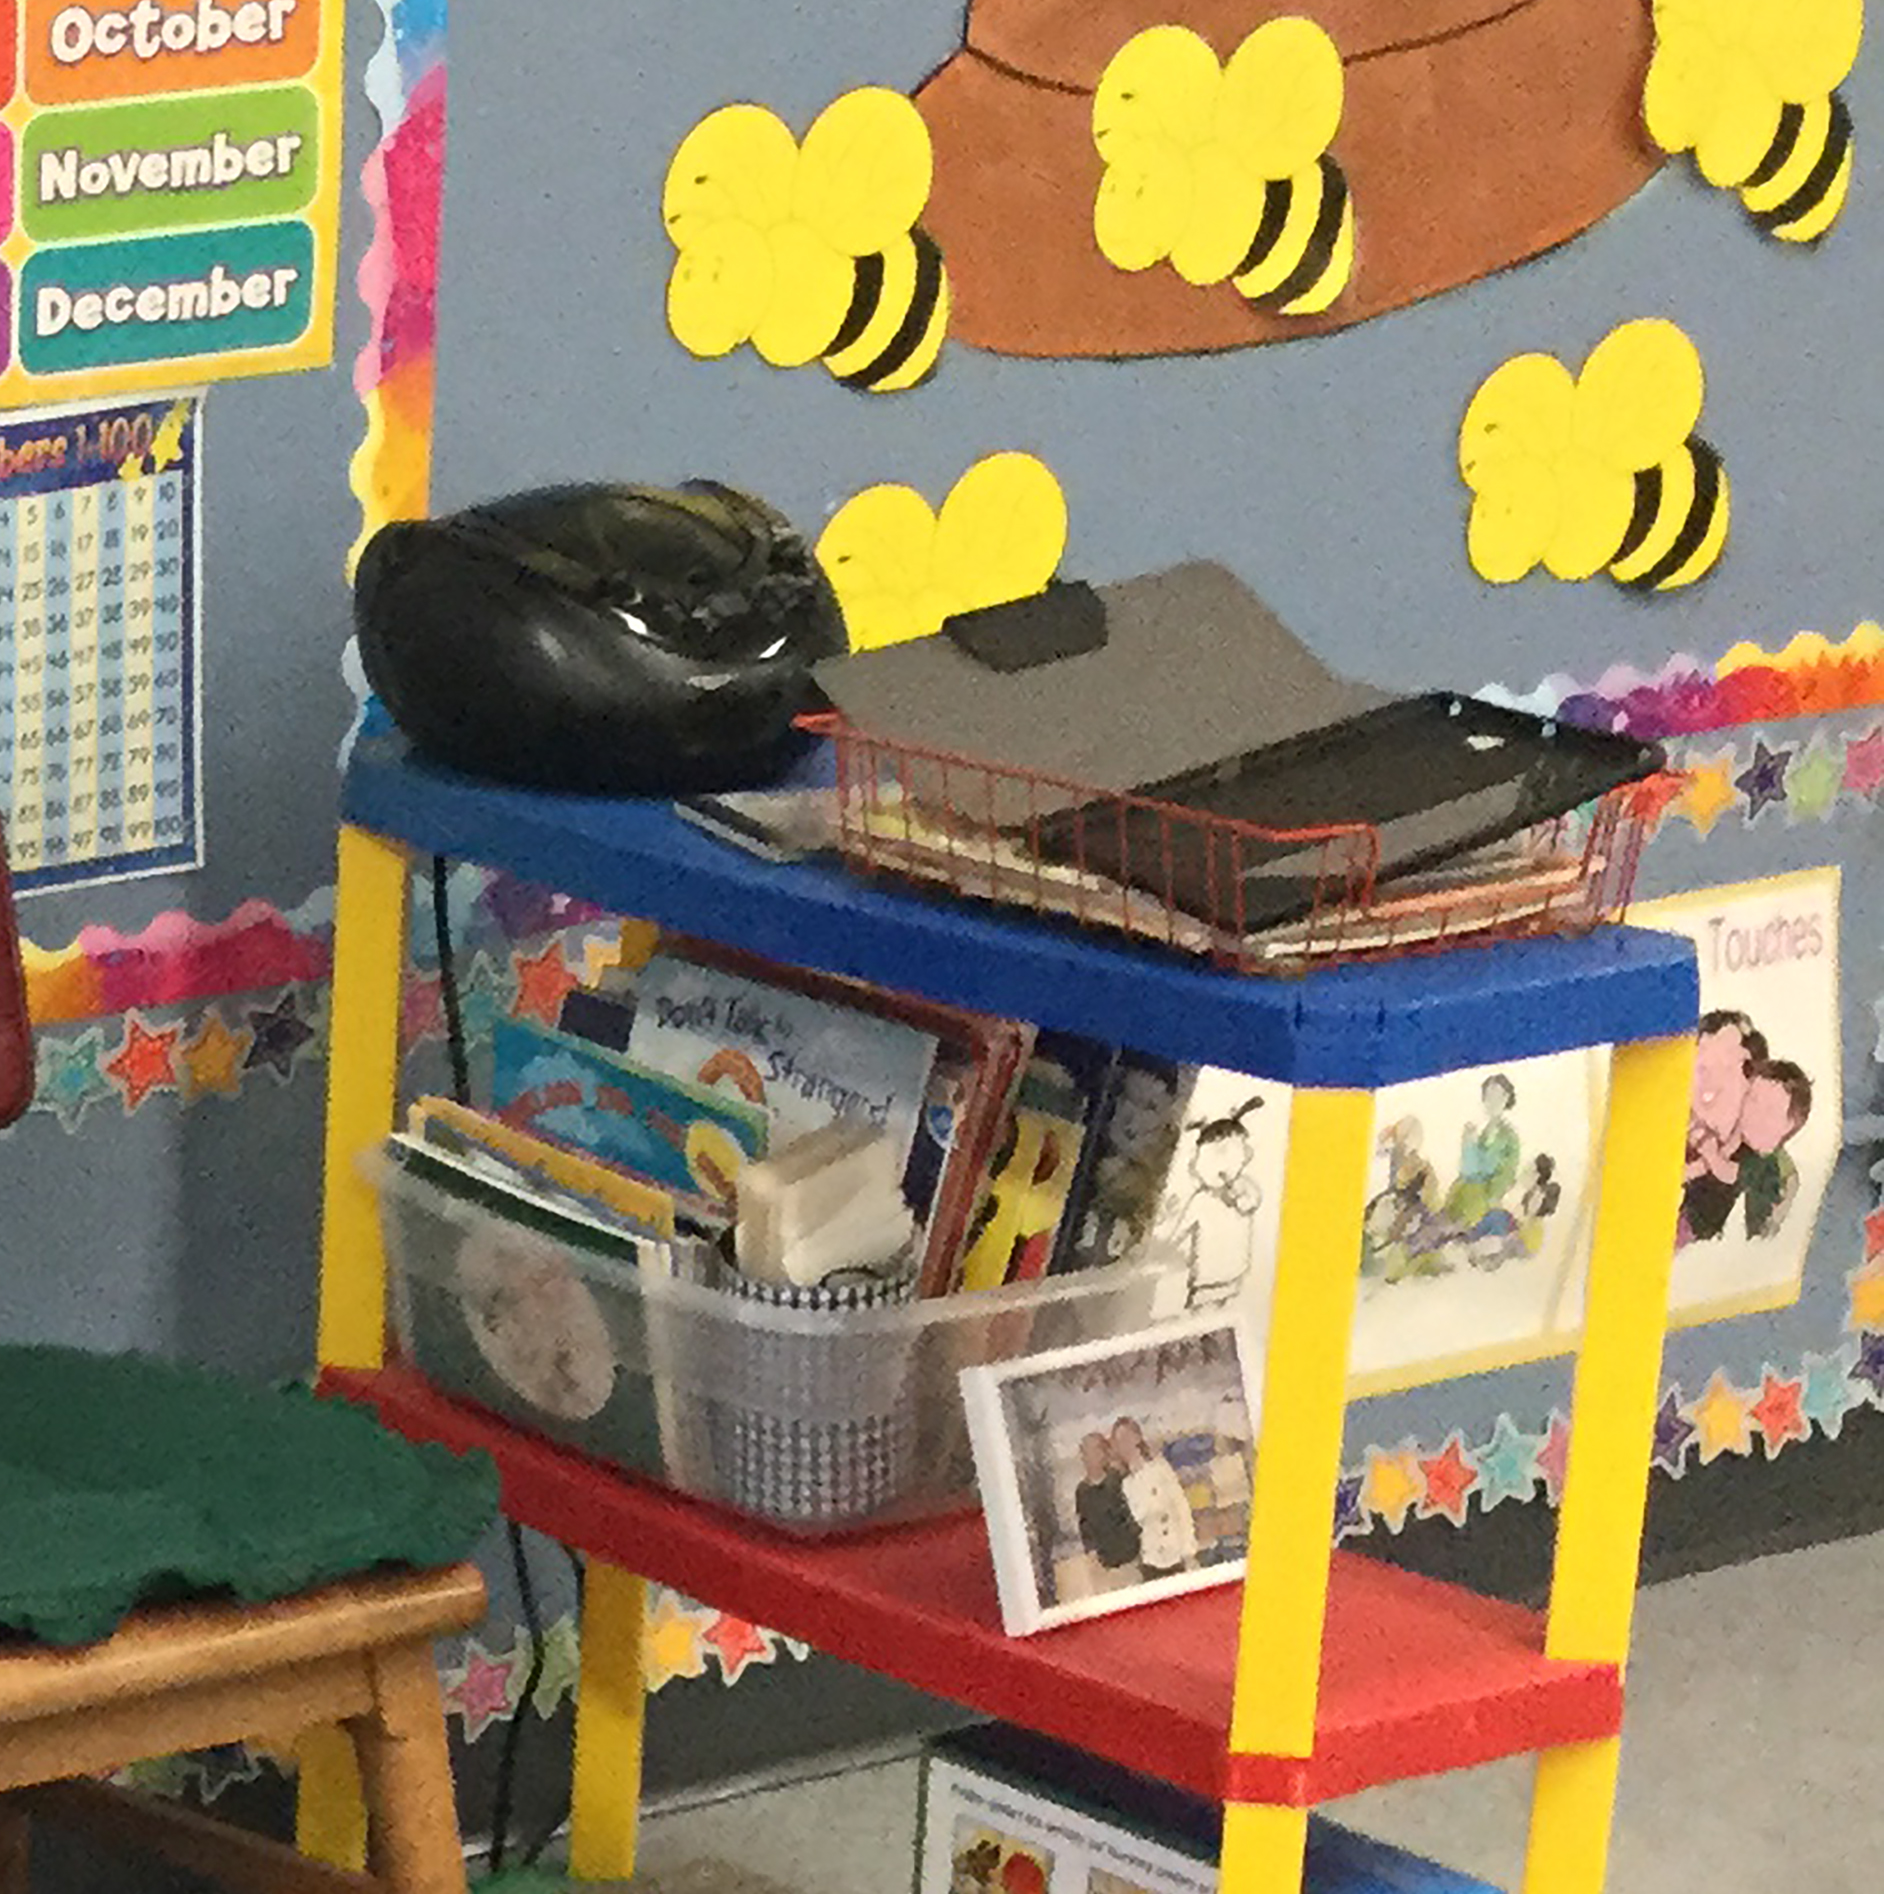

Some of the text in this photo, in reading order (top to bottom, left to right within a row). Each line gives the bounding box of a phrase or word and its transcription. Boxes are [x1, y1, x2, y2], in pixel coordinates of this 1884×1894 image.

[51, 0, 296, 62] October
[39, 131, 302, 202] November
[36, 265, 299, 338] December
